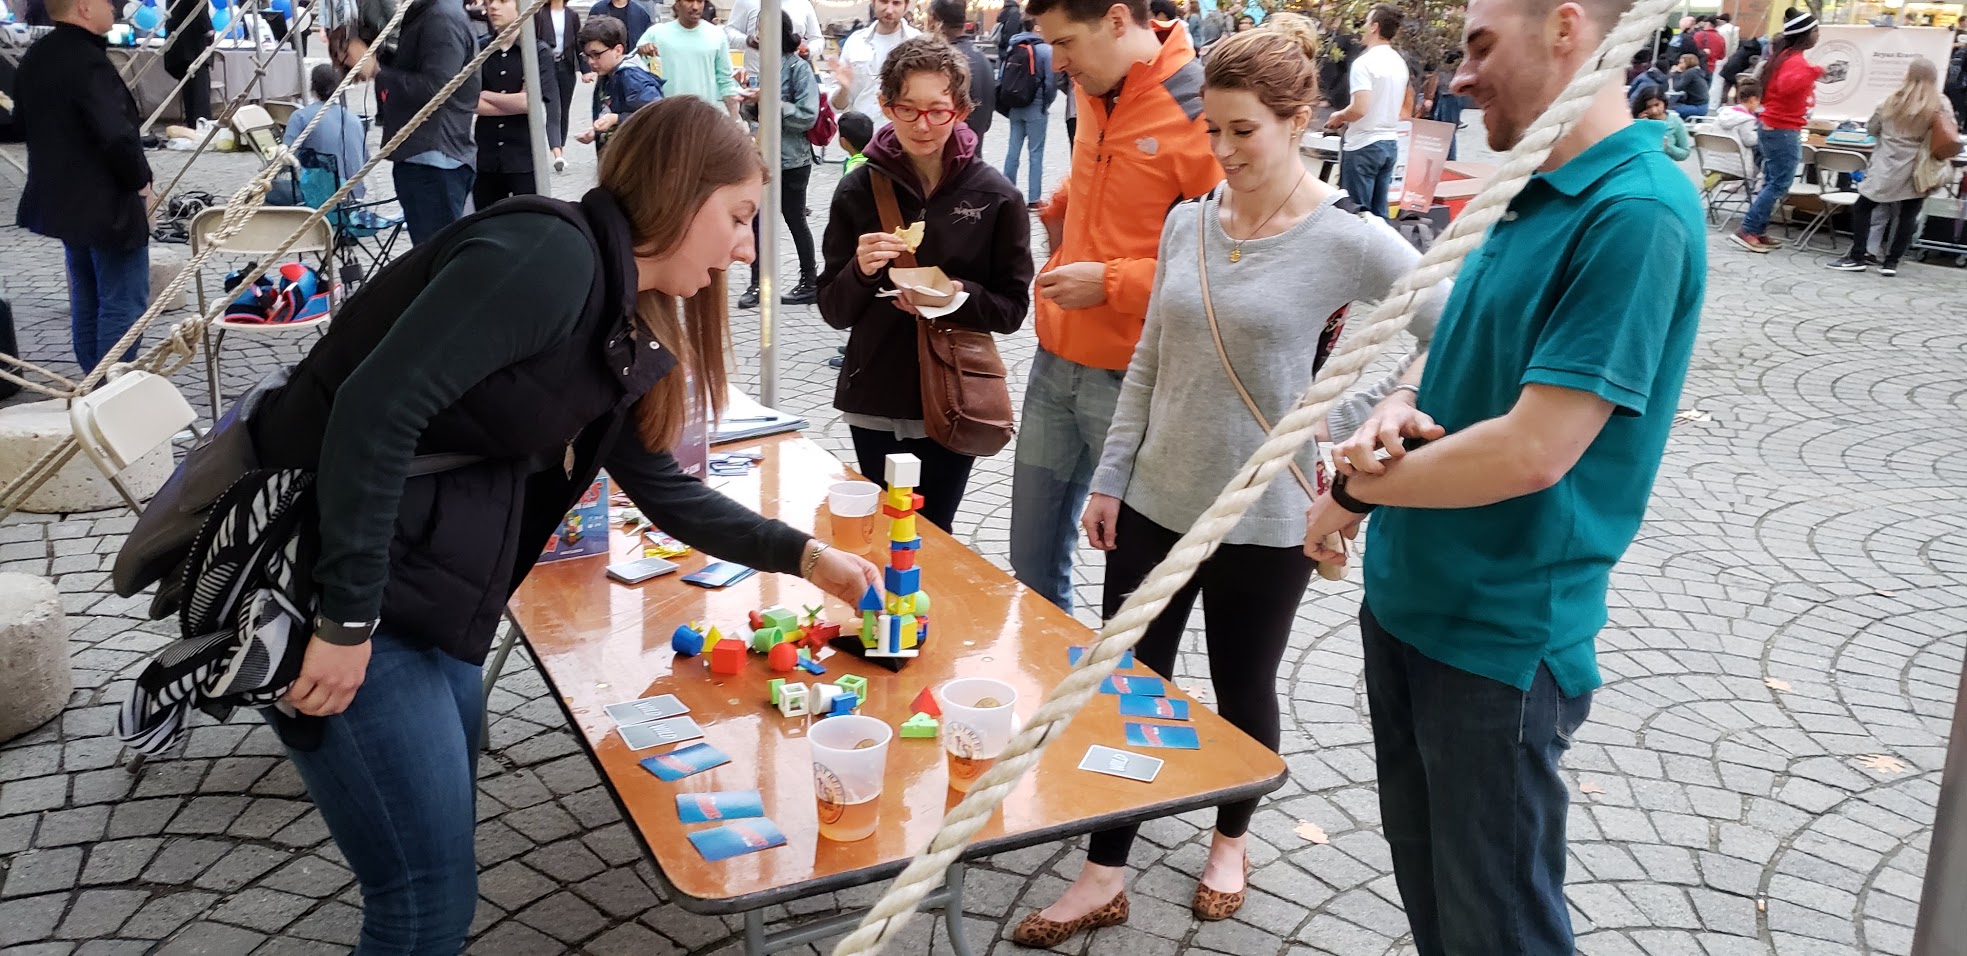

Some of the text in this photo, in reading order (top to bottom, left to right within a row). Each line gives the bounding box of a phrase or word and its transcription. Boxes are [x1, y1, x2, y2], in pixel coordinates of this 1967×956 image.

[632, 701, 662, 716] WILD
[648, 723, 677, 739] WILD
[1109, 753, 1128, 772] WILD
